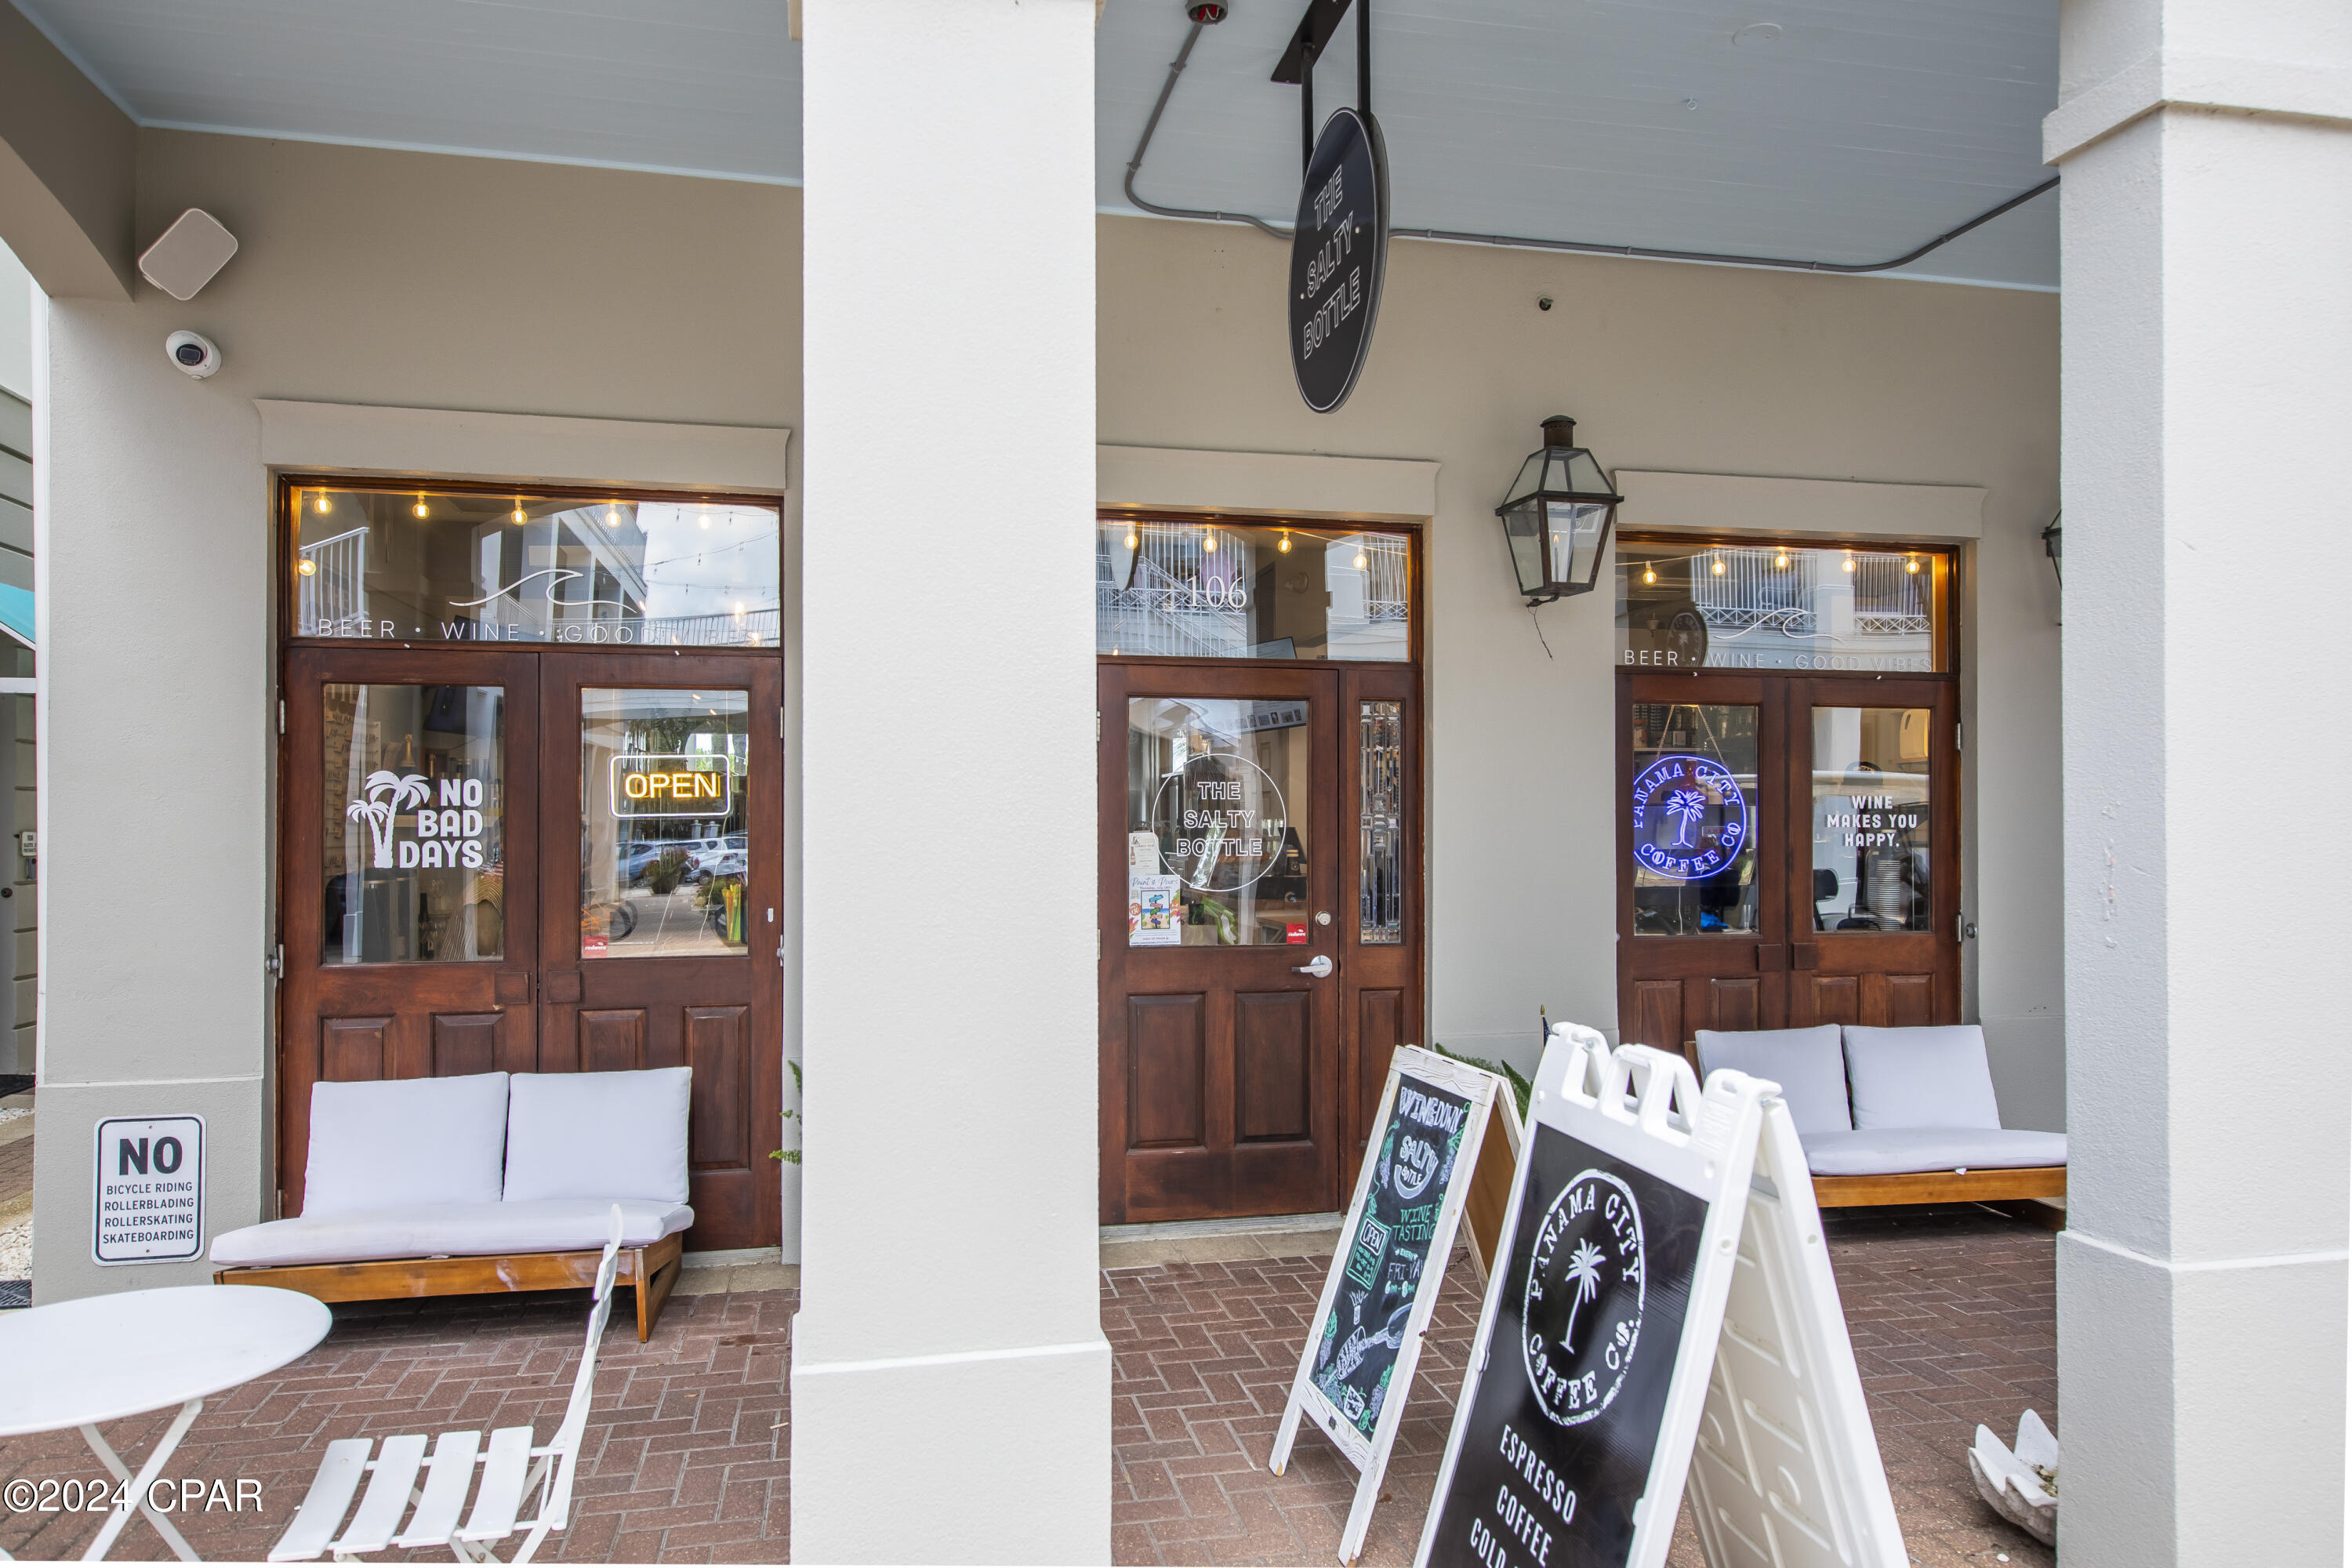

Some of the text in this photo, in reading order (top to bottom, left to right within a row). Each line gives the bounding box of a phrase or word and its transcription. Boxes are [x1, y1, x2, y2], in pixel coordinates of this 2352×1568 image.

[1314, 164, 1343, 231] THE
[1307, 210, 1353, 298] SALTY
[1304, 266, 1360, 360] BOTTLE
[1186, 575, 1247, 608] 106
[318, 619, 395, 639] BEER
[441, 622, 520, 641] WINE
[564, 625, 657, 644] GOOD
[1624, 649, 1933, 673] BEER WINE GOOD VIBES
[440, 779, 483, 807] NO
[625, 772, 717, 798] OPEN
[1197, 782, 1241, 800] THE
[1694, 765, 1740, 806] CITY
[1852, 796, 1893, 809] WINE
[417, 810, 484, 837] BAD
[1184, 810, 1255, 828] SALTY
[1827, 814, 1918, 828] MAKES YOU
[1177, 838, 1263, 856] BOTTLE
[1844, 833, 1900, 847] HAPPY.
[399, 840, 484, 869] DAYS
[1641, 843, 1721, 873] COFFEE
[119, 1136, 183, 1176] NO
[1399, 1135, 1439, 1171] SALTY
[107, 1181, 193, 1195] BICYCLE RIDING
[104, 1198, 194, 1211] ROLLERBLADING
[1400, 1203, 1433, 1223] WINE
[104, 1214, 194, 1228] ROLLERSKATING
[1392, 1223, 1436, 1241] TASTING
[103, 1230, 194, 1243] SKATEBOARDING
[1363, 1223, 1383, 1250] OPEN
[1530, 1184, 1640, 1301] PANAMA CITY
[1530, 1334, 1599, 1410] COFFEE
[1500, 1424, 1577, 1525] ESPRESSO
[1497, 1485, 1553, 1568] COFFEE
[1470, 1518, 1507, 1568] COLD
